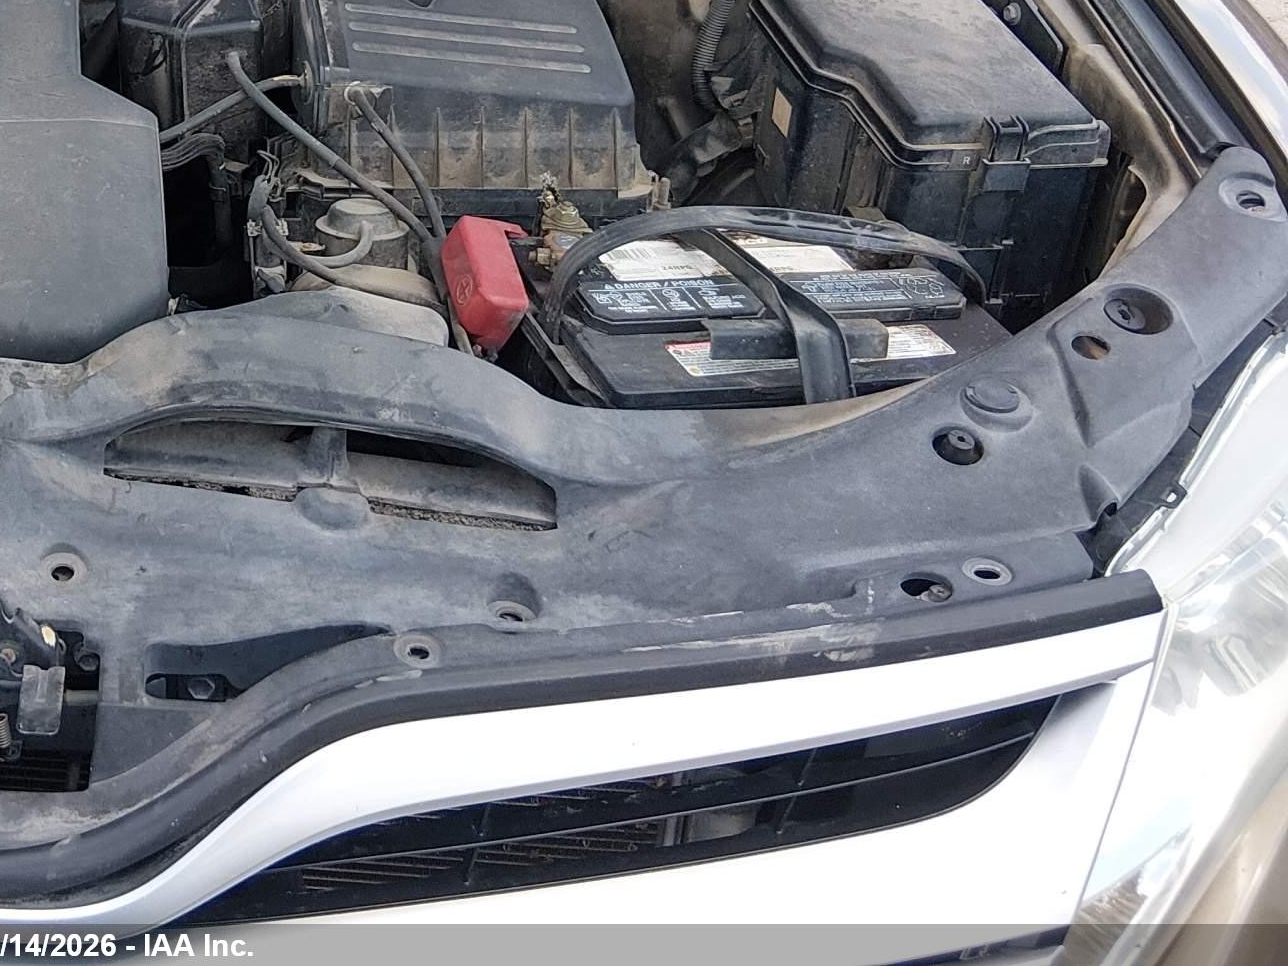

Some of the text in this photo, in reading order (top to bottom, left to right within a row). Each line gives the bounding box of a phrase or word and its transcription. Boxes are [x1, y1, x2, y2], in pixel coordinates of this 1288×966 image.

[962, 156, 971, 165] R
[614, 281, 661, 290] DANGER
[671, 279, 715, 287] POISON
